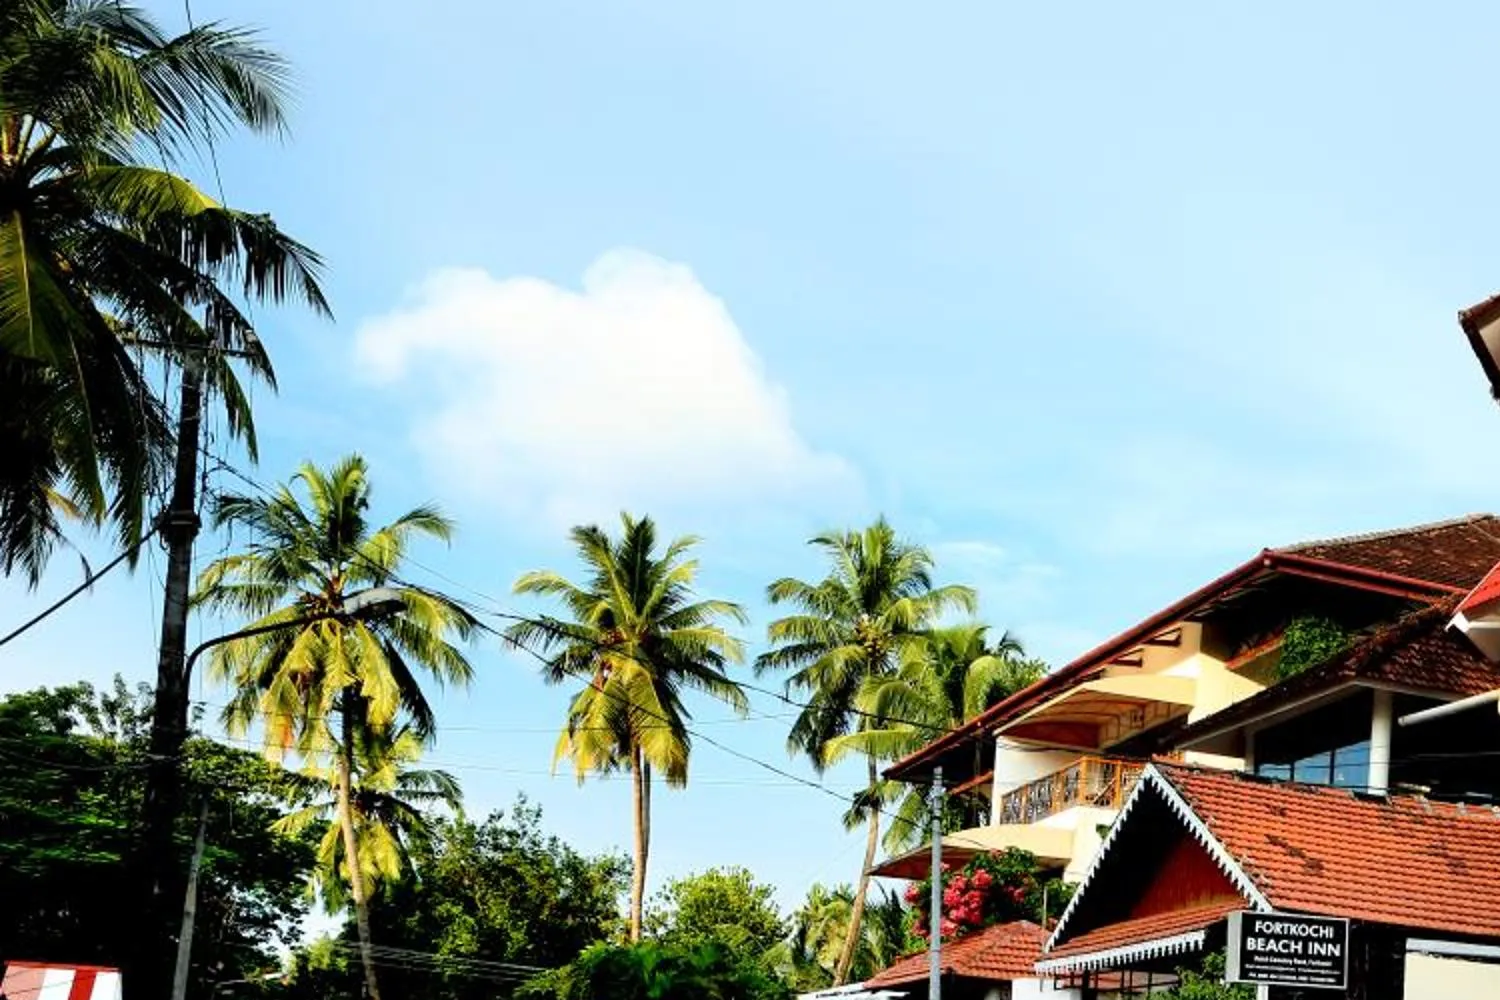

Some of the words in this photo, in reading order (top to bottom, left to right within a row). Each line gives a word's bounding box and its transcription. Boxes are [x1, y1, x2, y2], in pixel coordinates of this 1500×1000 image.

[1255, 920, 1334, 938] FORTKOCHI
[1247, 937, 1302, 954] BEACH
[1307, 941, 1341, 956] INN
